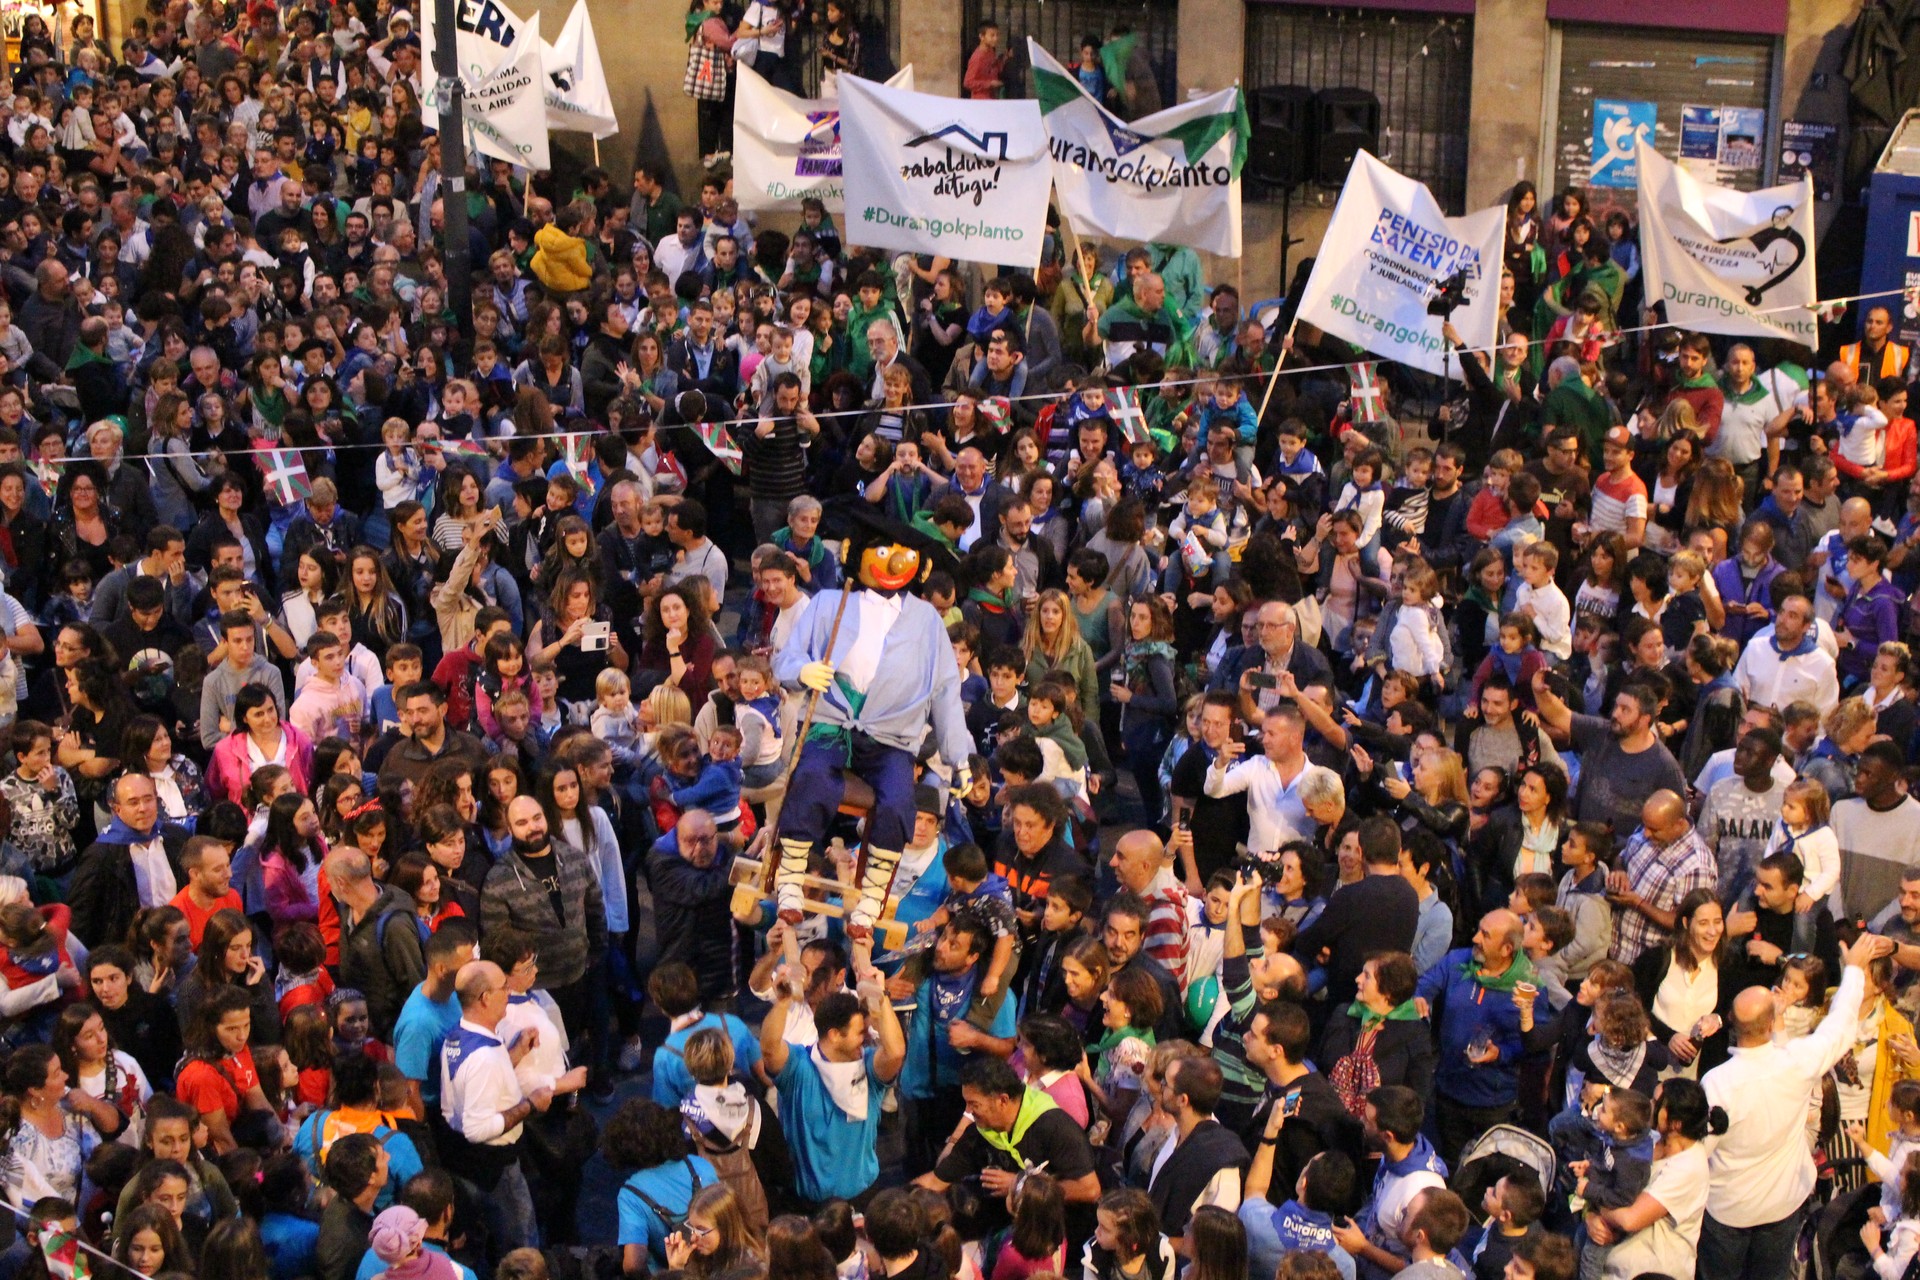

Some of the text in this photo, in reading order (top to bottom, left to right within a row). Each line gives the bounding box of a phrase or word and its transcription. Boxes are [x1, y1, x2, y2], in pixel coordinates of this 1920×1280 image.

[480, 76, 532, 98] CALIDAD
[488, 96, 516, 111] AIRE
[1050, 136, 1231, 192] urangokplanto
[863, 206, 1024, 241] #Durangokplanto
[1378, 207, 1459, 256] PENTSIO
[1370, 224, 1443, 270] BATEN
[1700, 255, 1739, 268] ETXERA
[1377, 268, 1422, 294] JUBILADAS
[1283, 1215, 1332, 1241] Durango
